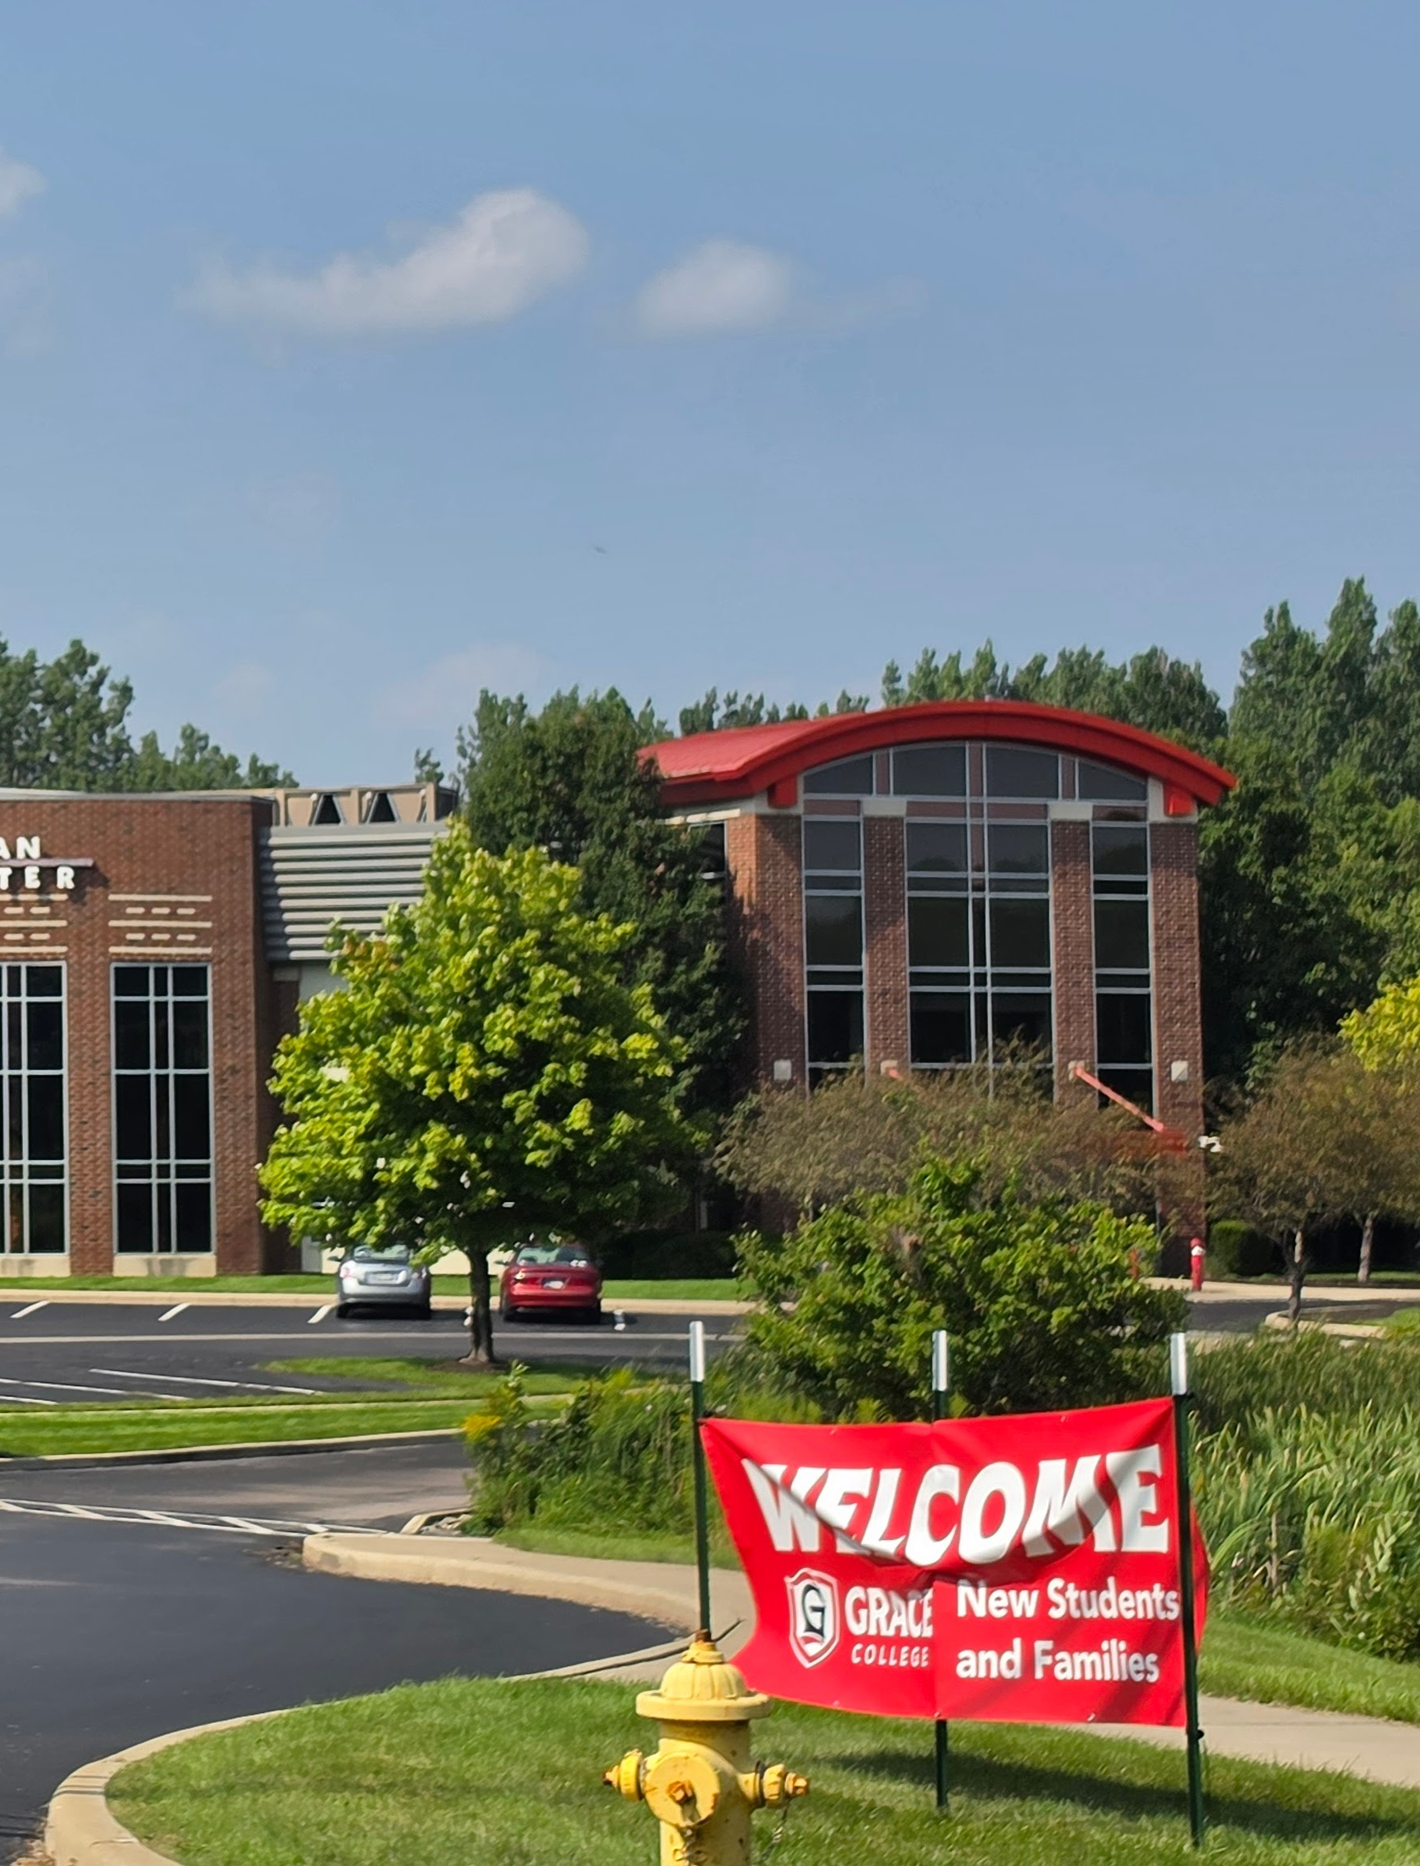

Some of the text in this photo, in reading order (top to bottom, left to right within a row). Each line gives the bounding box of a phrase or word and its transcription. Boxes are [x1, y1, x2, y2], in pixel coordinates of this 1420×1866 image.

[741, 1443, 1170, 1567] WELCOME
[844, 1585, 934, 1639] GRACE
[956, 1575, 1181, 1621] New Students
[851, 1643, 930, 1667] COLLEGE
[956, 1637, 1161, 1683] and Families
